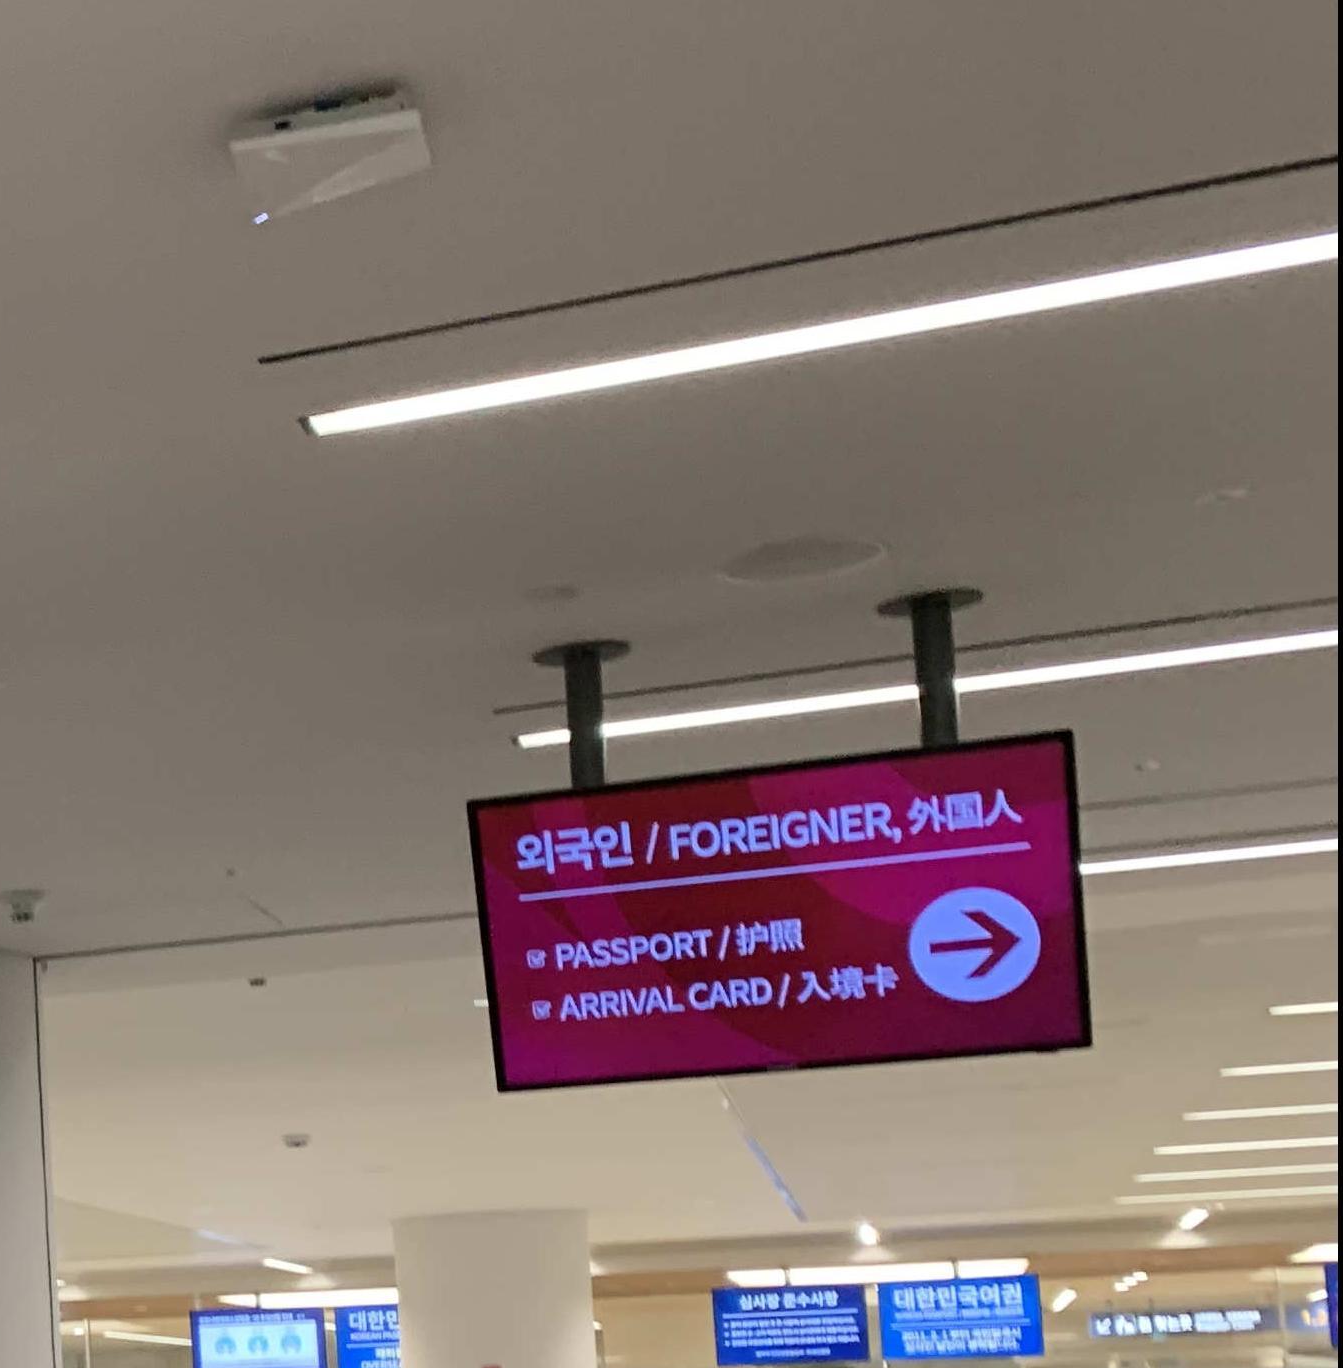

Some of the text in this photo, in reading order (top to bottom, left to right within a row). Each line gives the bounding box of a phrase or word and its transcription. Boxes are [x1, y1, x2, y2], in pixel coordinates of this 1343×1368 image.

[516, 820, 634, 875] 외국인
[669, 801, 903, 861] FOREIGNER,
[908, 788, 1023, 835] 外国人
[556, 928, 712, 971] PASSPORT
[735, 918, 805, 958] 护照
[559, 983, 686, 1023] ARRIVAL
[688, 977, 774, 1011] CARD
[796, 964, 899, 1005] 入境卡
